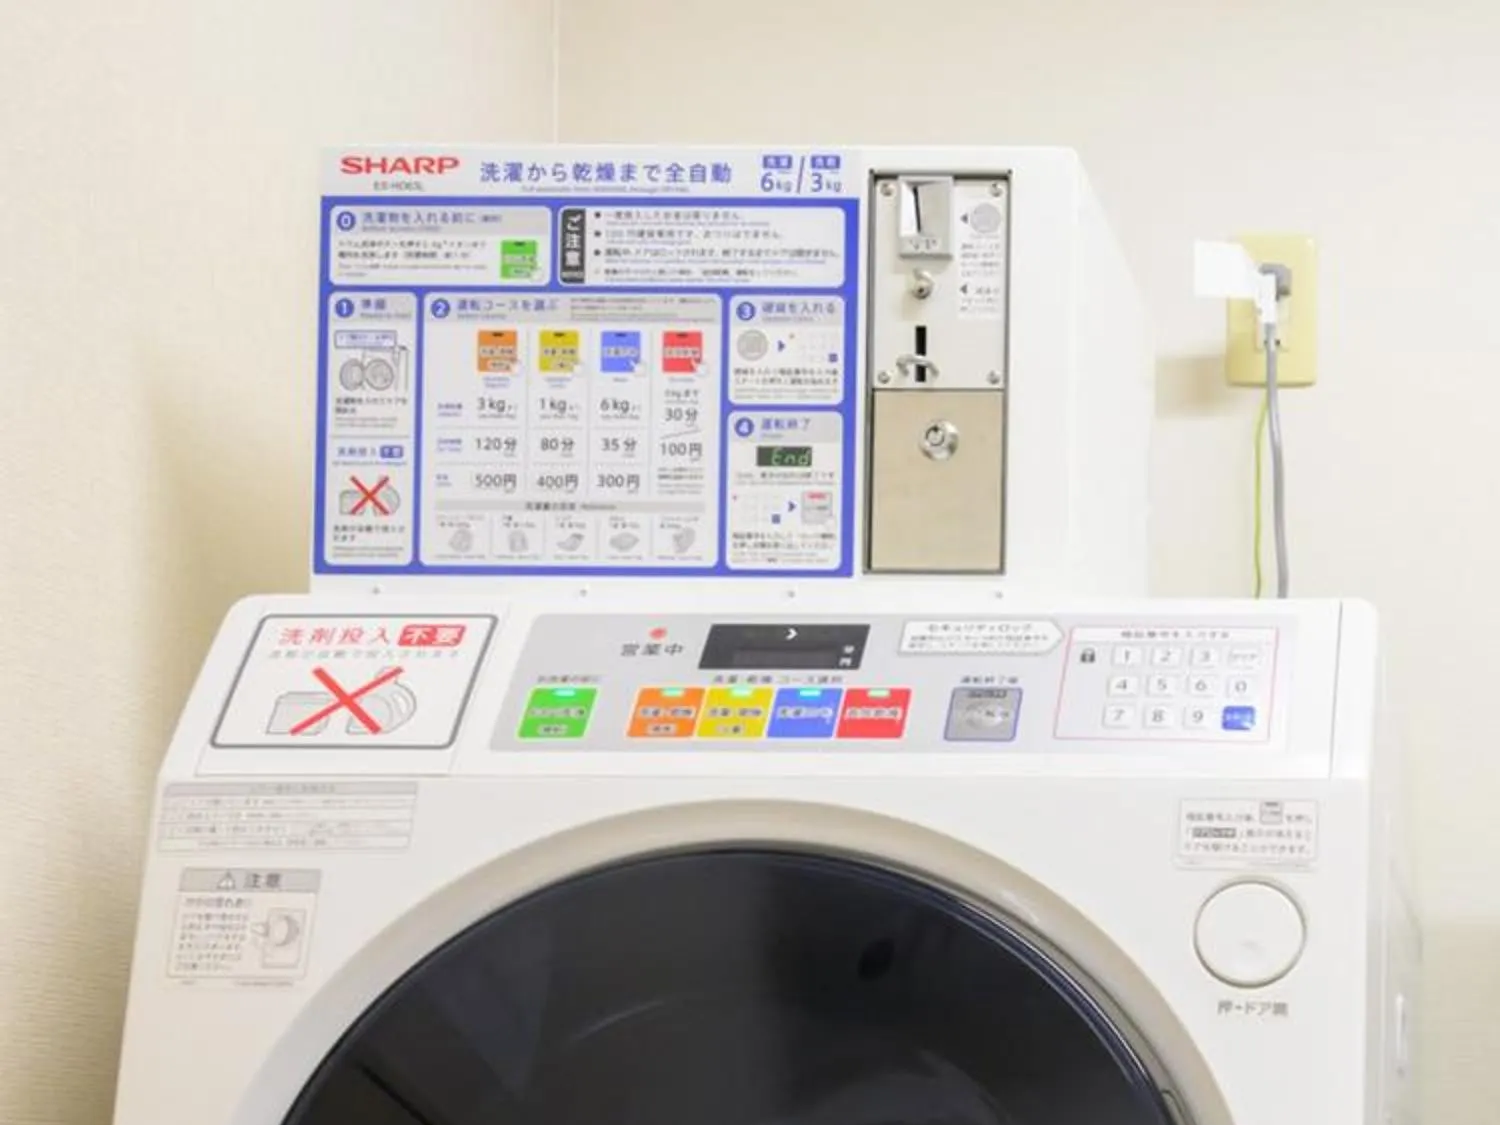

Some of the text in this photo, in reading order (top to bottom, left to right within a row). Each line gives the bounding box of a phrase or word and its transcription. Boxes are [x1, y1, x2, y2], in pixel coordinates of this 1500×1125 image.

[340, 157, 460, 174] SHARP
[480, 161, 732, 183] 洗濯から乾燥まで全自動
[565, 213, 582, 267] ご注意
[664, 407, 699, 422] 30分
[476, 437, 517, 452] 120分
[541, 437, 576, 452] 80分
[600, 437, 638, 452] 35分
[660, 441, 703, 457] 100円
[475, 473, 517, 489] 500円
[537, 473, 579, 489] 400円
[278, 626, 462, 645] 洗剤投入 不要
[620, 643, 685, 657] 営業中
[1159, 649, 1172, 664] 2
[1199, 649, 1211, 664] 3
[1115, 679, 1128, 692] 4
[1156, 679, 1169, 692] 5
[1194, 679, 1208, 692] 6
[1112, 709, 1127, 722] 7
[1151, 709, 1166, 723] 8
[1191, 709, 1205, 723] 9
[244, 873, 283, 889] 注意
